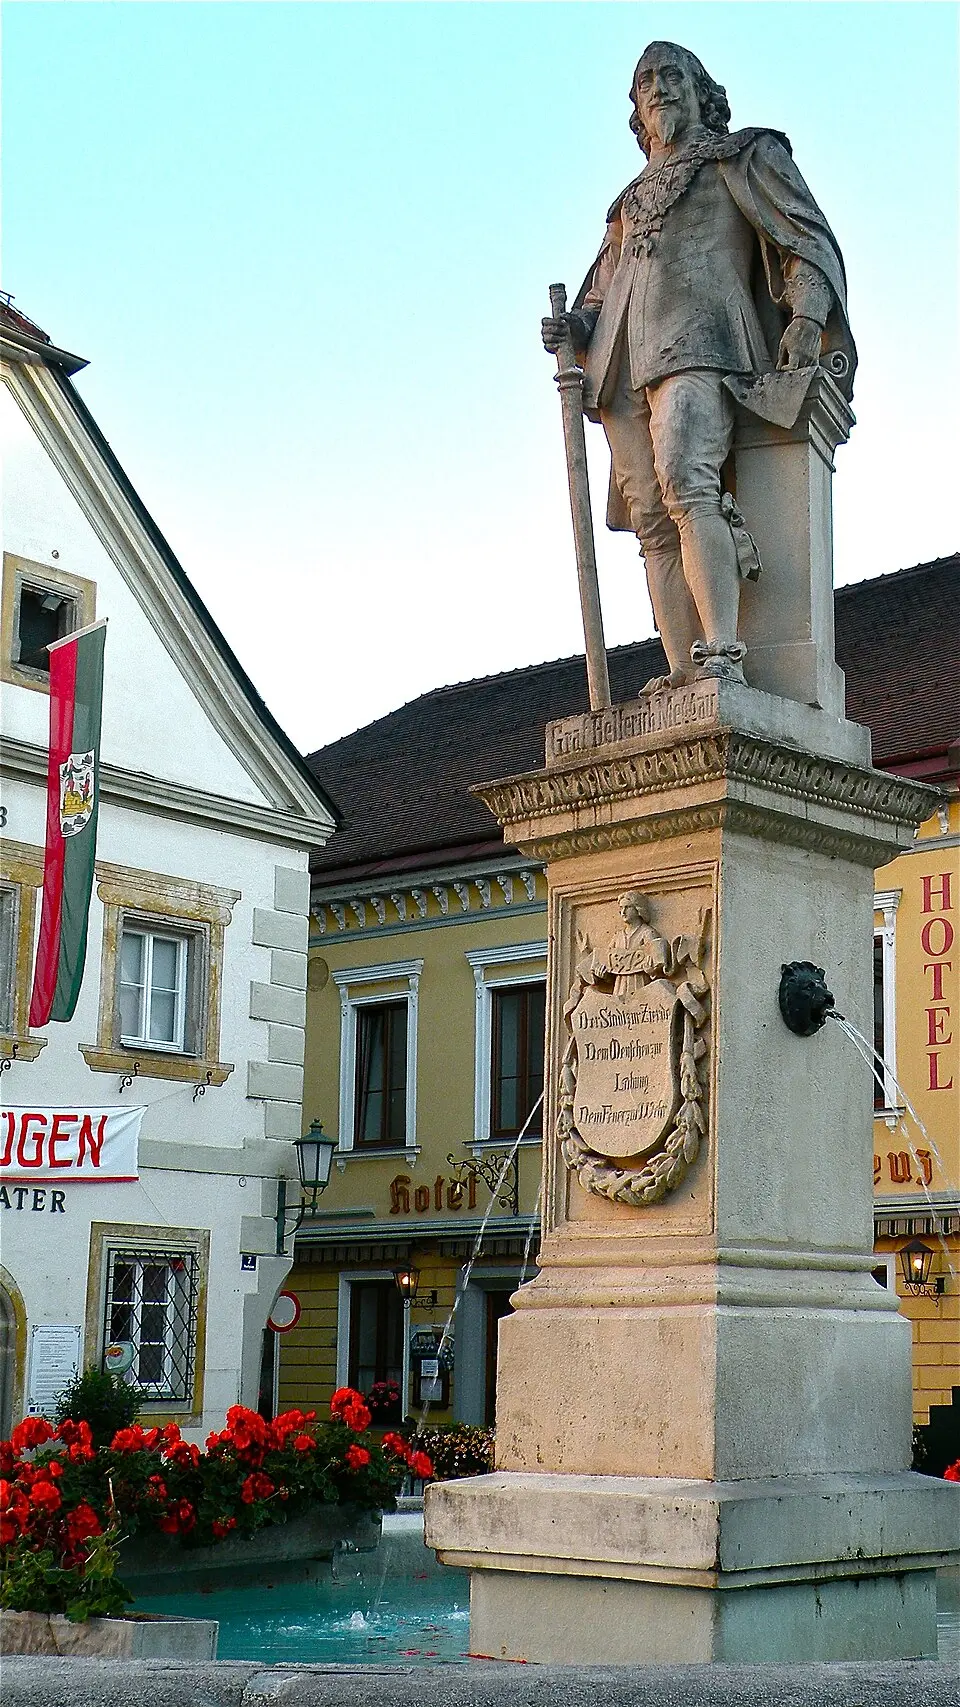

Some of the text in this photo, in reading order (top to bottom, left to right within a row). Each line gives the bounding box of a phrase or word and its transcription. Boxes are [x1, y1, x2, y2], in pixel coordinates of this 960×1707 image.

[919, 871, 955, 1092] HOTEL
[579, 1011, 600, 1029] Der
[584, 1042, 609, 1060] Dem
[579, 1106, 603, 1124] Dem
[0, 1186, 66, 1213] ATER
[389, 1170, 480, 1214] Hotel
